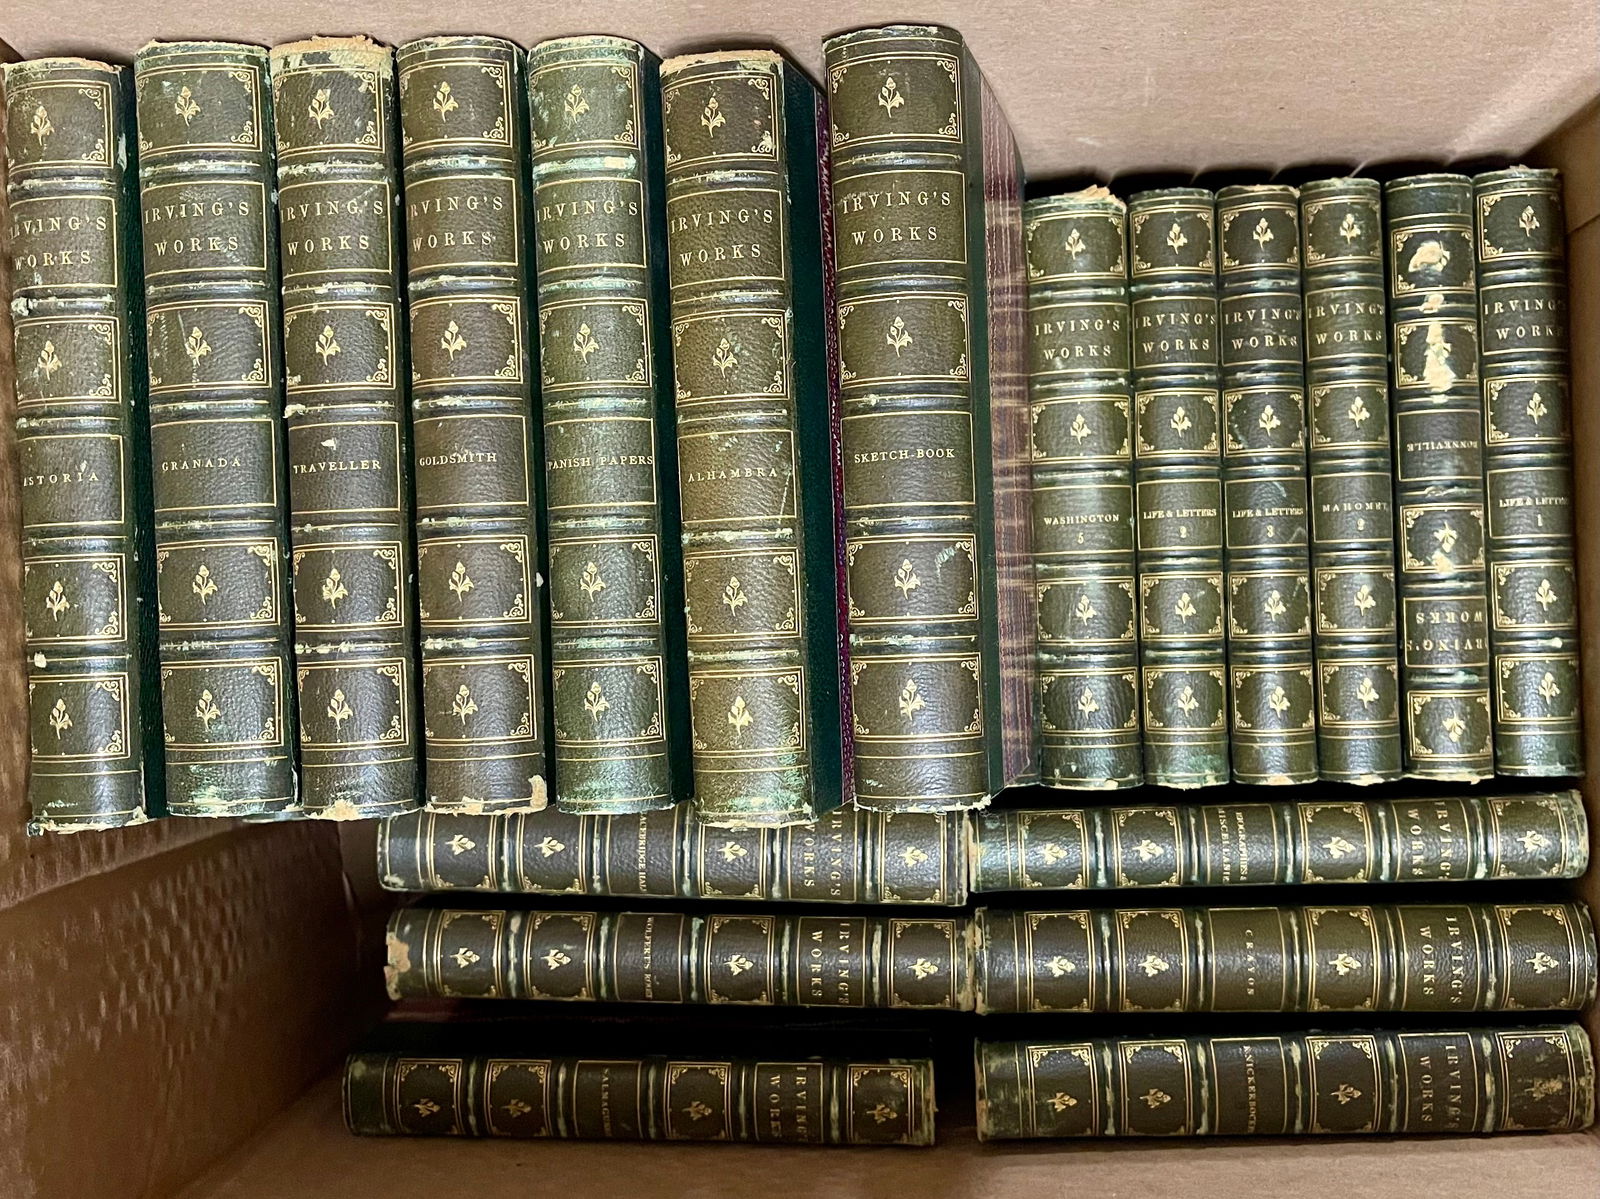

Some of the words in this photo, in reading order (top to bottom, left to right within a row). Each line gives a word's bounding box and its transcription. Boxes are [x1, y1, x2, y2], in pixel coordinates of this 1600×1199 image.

[144, 201, 250, 225] IRVING'S
[280, 199, 384, 224] IRVING'S
[407, 195, 503, 221] RVING'S
[536, 199, 639, 224] IRVING'S
[842, 191, 952, 214] IRVING'S
[670, 208, 774, 235] IRVING'S
[154, 236, 240, 257] WORKS
[287, 235, 370, 256] WORKS
[412, 230, 492, 251] WORKS
[543, 233, 626, 254] WORKS
[852, 226, 938, 246] WORKS
[14, 250, 92, 271] WORKS
[680, 243, 762, 267] WORKS
[1035, 318, 1121, 336] IRVING'S
[1315, 329, 1383, 346] WORKS
[1044, 345, 1112, 361] WORKS
[1143, 338, 1210, 354] WORKS
[1231, 334, 1298, 351] WORKS
[161, 458, 242, 473] GRANADA
[292, 459, 382, 475] TRAVELLER
[419, 452, 498, 468] GOLDSMITH
[600, 455, 654, 467] PAPERS
[688, 467, 779, 484] ALHAMBRA
[1043, 513, 1120, 526] WASHINGTON
[1176, 508, 1217, 519] LETTERS
[1415, 611, 1484, 625] WORKS
[639, 813, 648, 871] ACEBRIDGE
[1407, 808, 1424, 877] WORKS
[832, 810, 843, 898] IRVING'S
[811, 930, 823, 998] WORKS
[838, 921, 850, 1004] IRVING'S
[1419, 925, 1435, 996] WORKS
[1446, 915, 1464, 1005] IRVING'S
[1419, 1056, 1434, 1123] WORKS
[1445, 1044, 1463, 1131] IRVING'S
